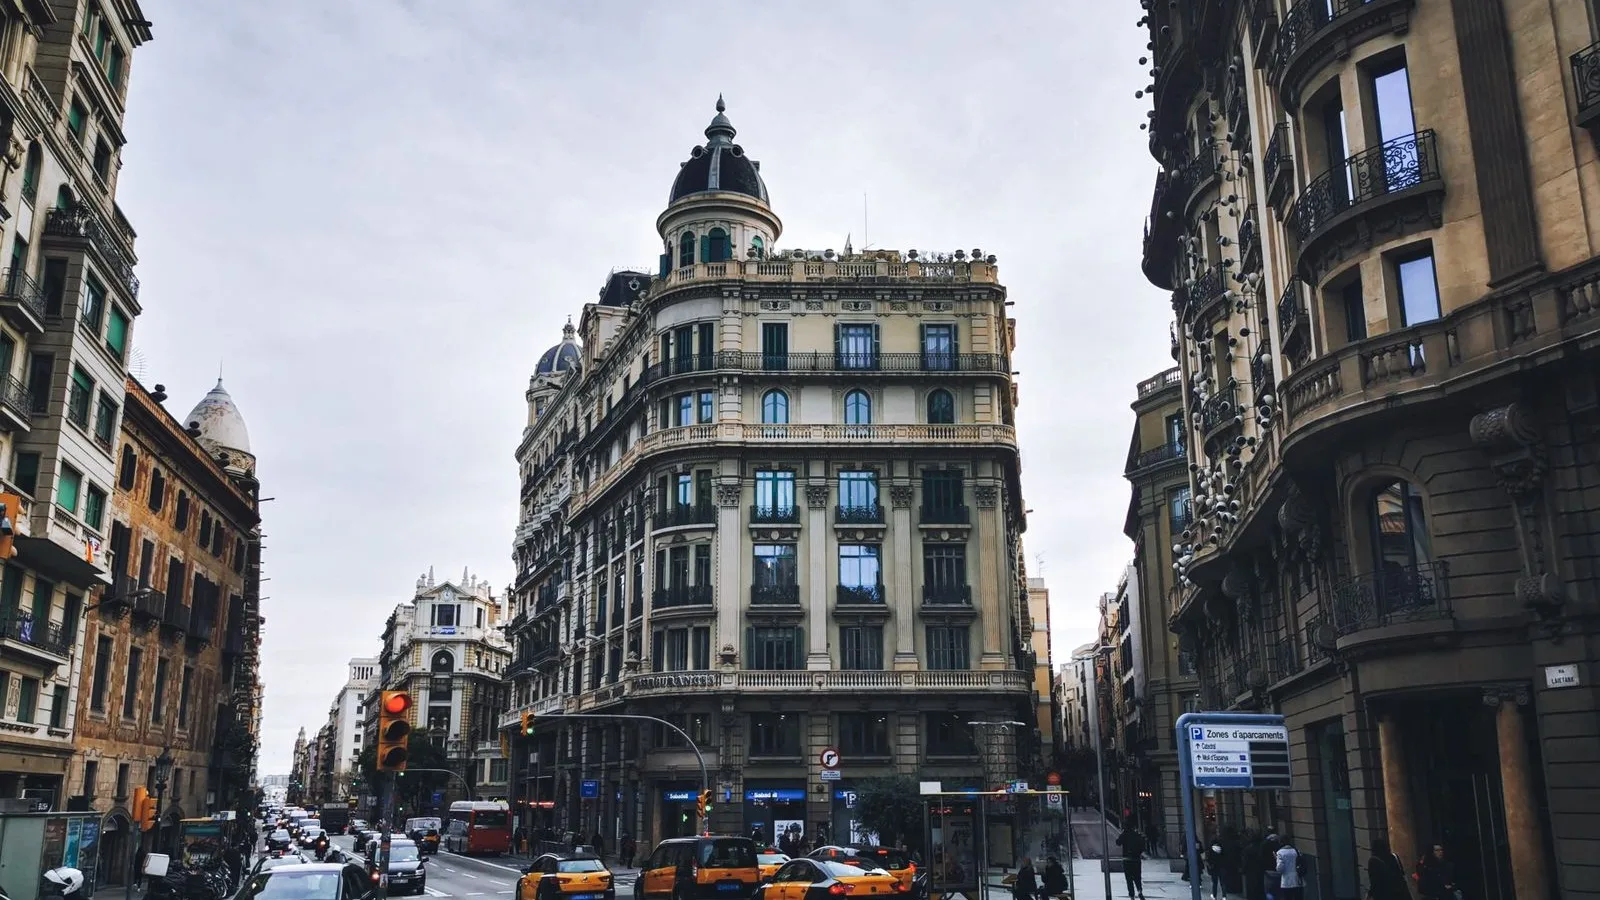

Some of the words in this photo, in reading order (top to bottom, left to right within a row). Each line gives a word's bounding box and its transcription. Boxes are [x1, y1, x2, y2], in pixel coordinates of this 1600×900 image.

[1192, 728, 1201, 739] P
[1206, 730, 1229, 739] Zones
[1232, 730, 1284, 740] d'aparcaments
